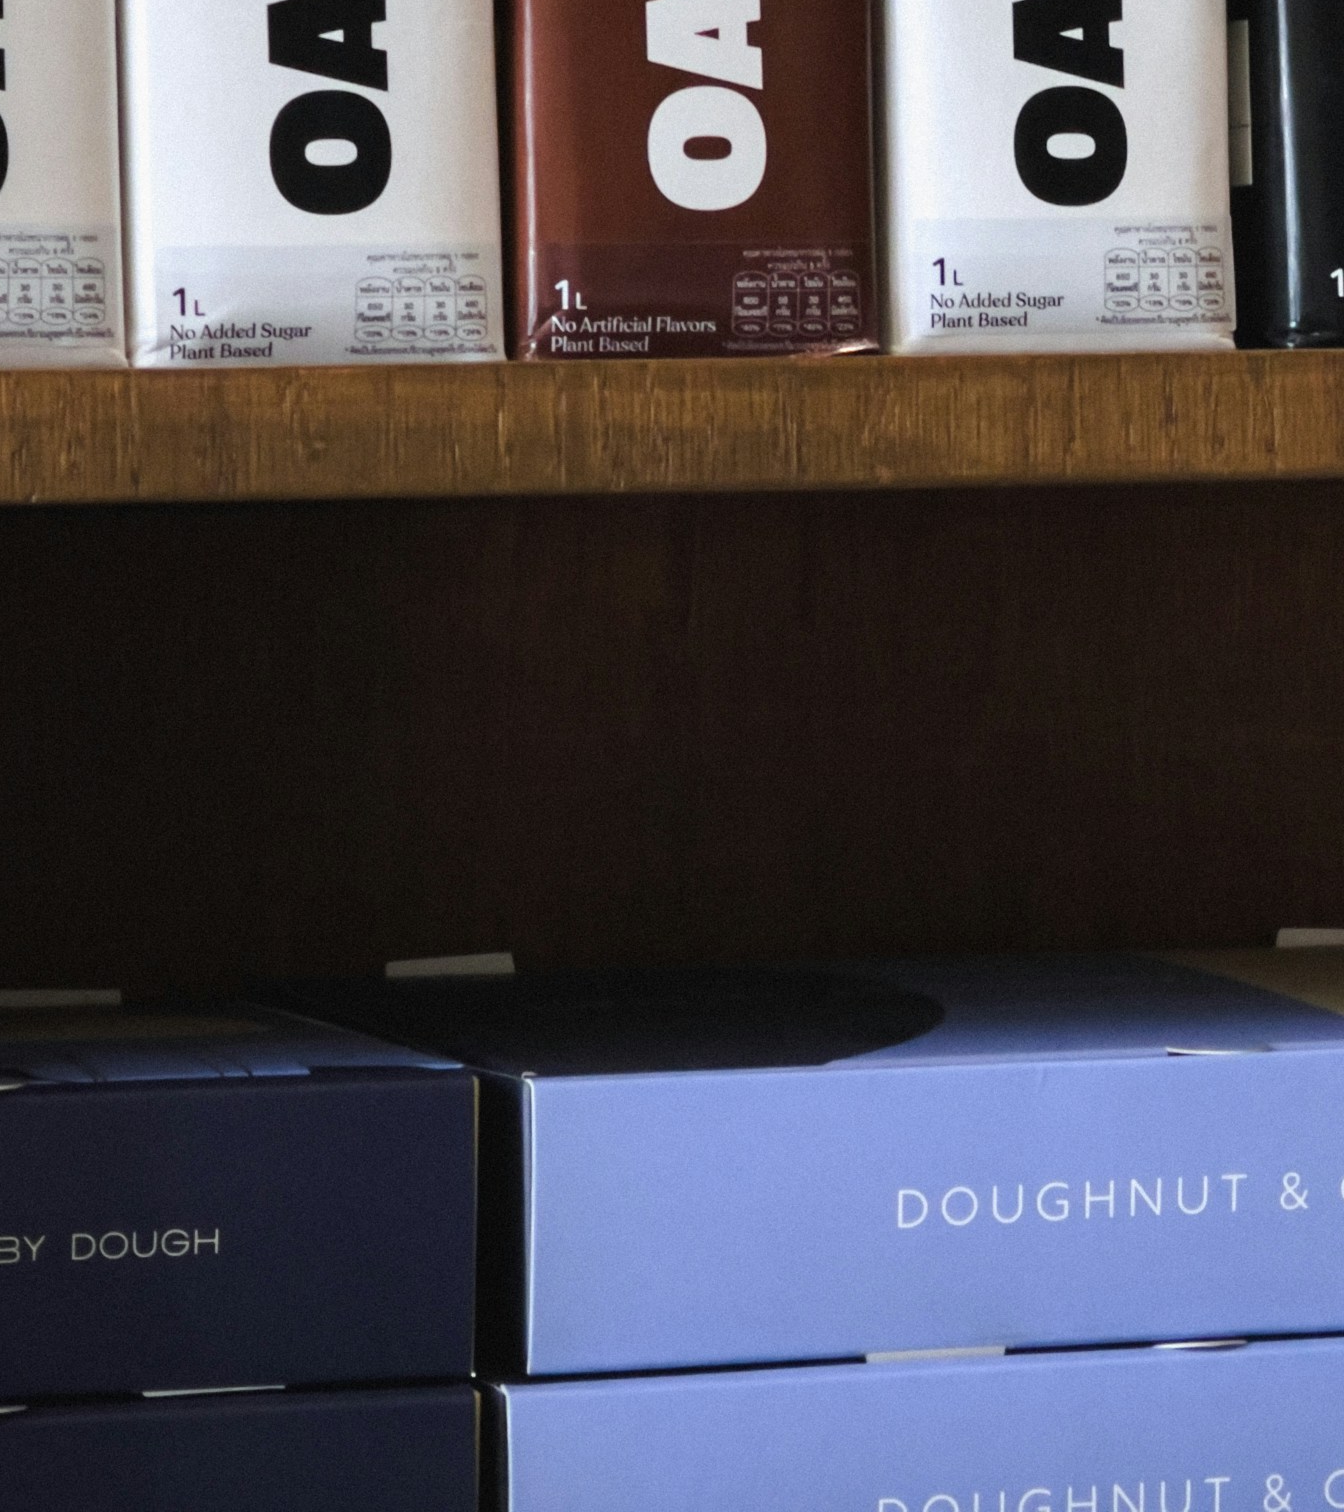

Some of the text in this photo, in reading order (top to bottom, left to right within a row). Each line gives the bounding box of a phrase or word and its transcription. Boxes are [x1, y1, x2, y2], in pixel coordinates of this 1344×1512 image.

[930, 292, 1064, 314] No Added Sugar
[551, 316, 577, 333] No
[579, 316, 653, 333] Artificial
[655, 316, 717, 333] Flavors
[931, 311, 1028, 329] Plant Based
[169, 322, 312, 347] No Added Sugar
[550, 335, 650, 353] Plant Based
[169, 341, 273, 361] Plant Based
[897, 1173, 1248, 1229] DOUGHNUT
[1279, 1171, 1309, 1211] &
[71, 1228, 220, 1261] DOUGH
[1263, 1473, 1292, 1512] &
